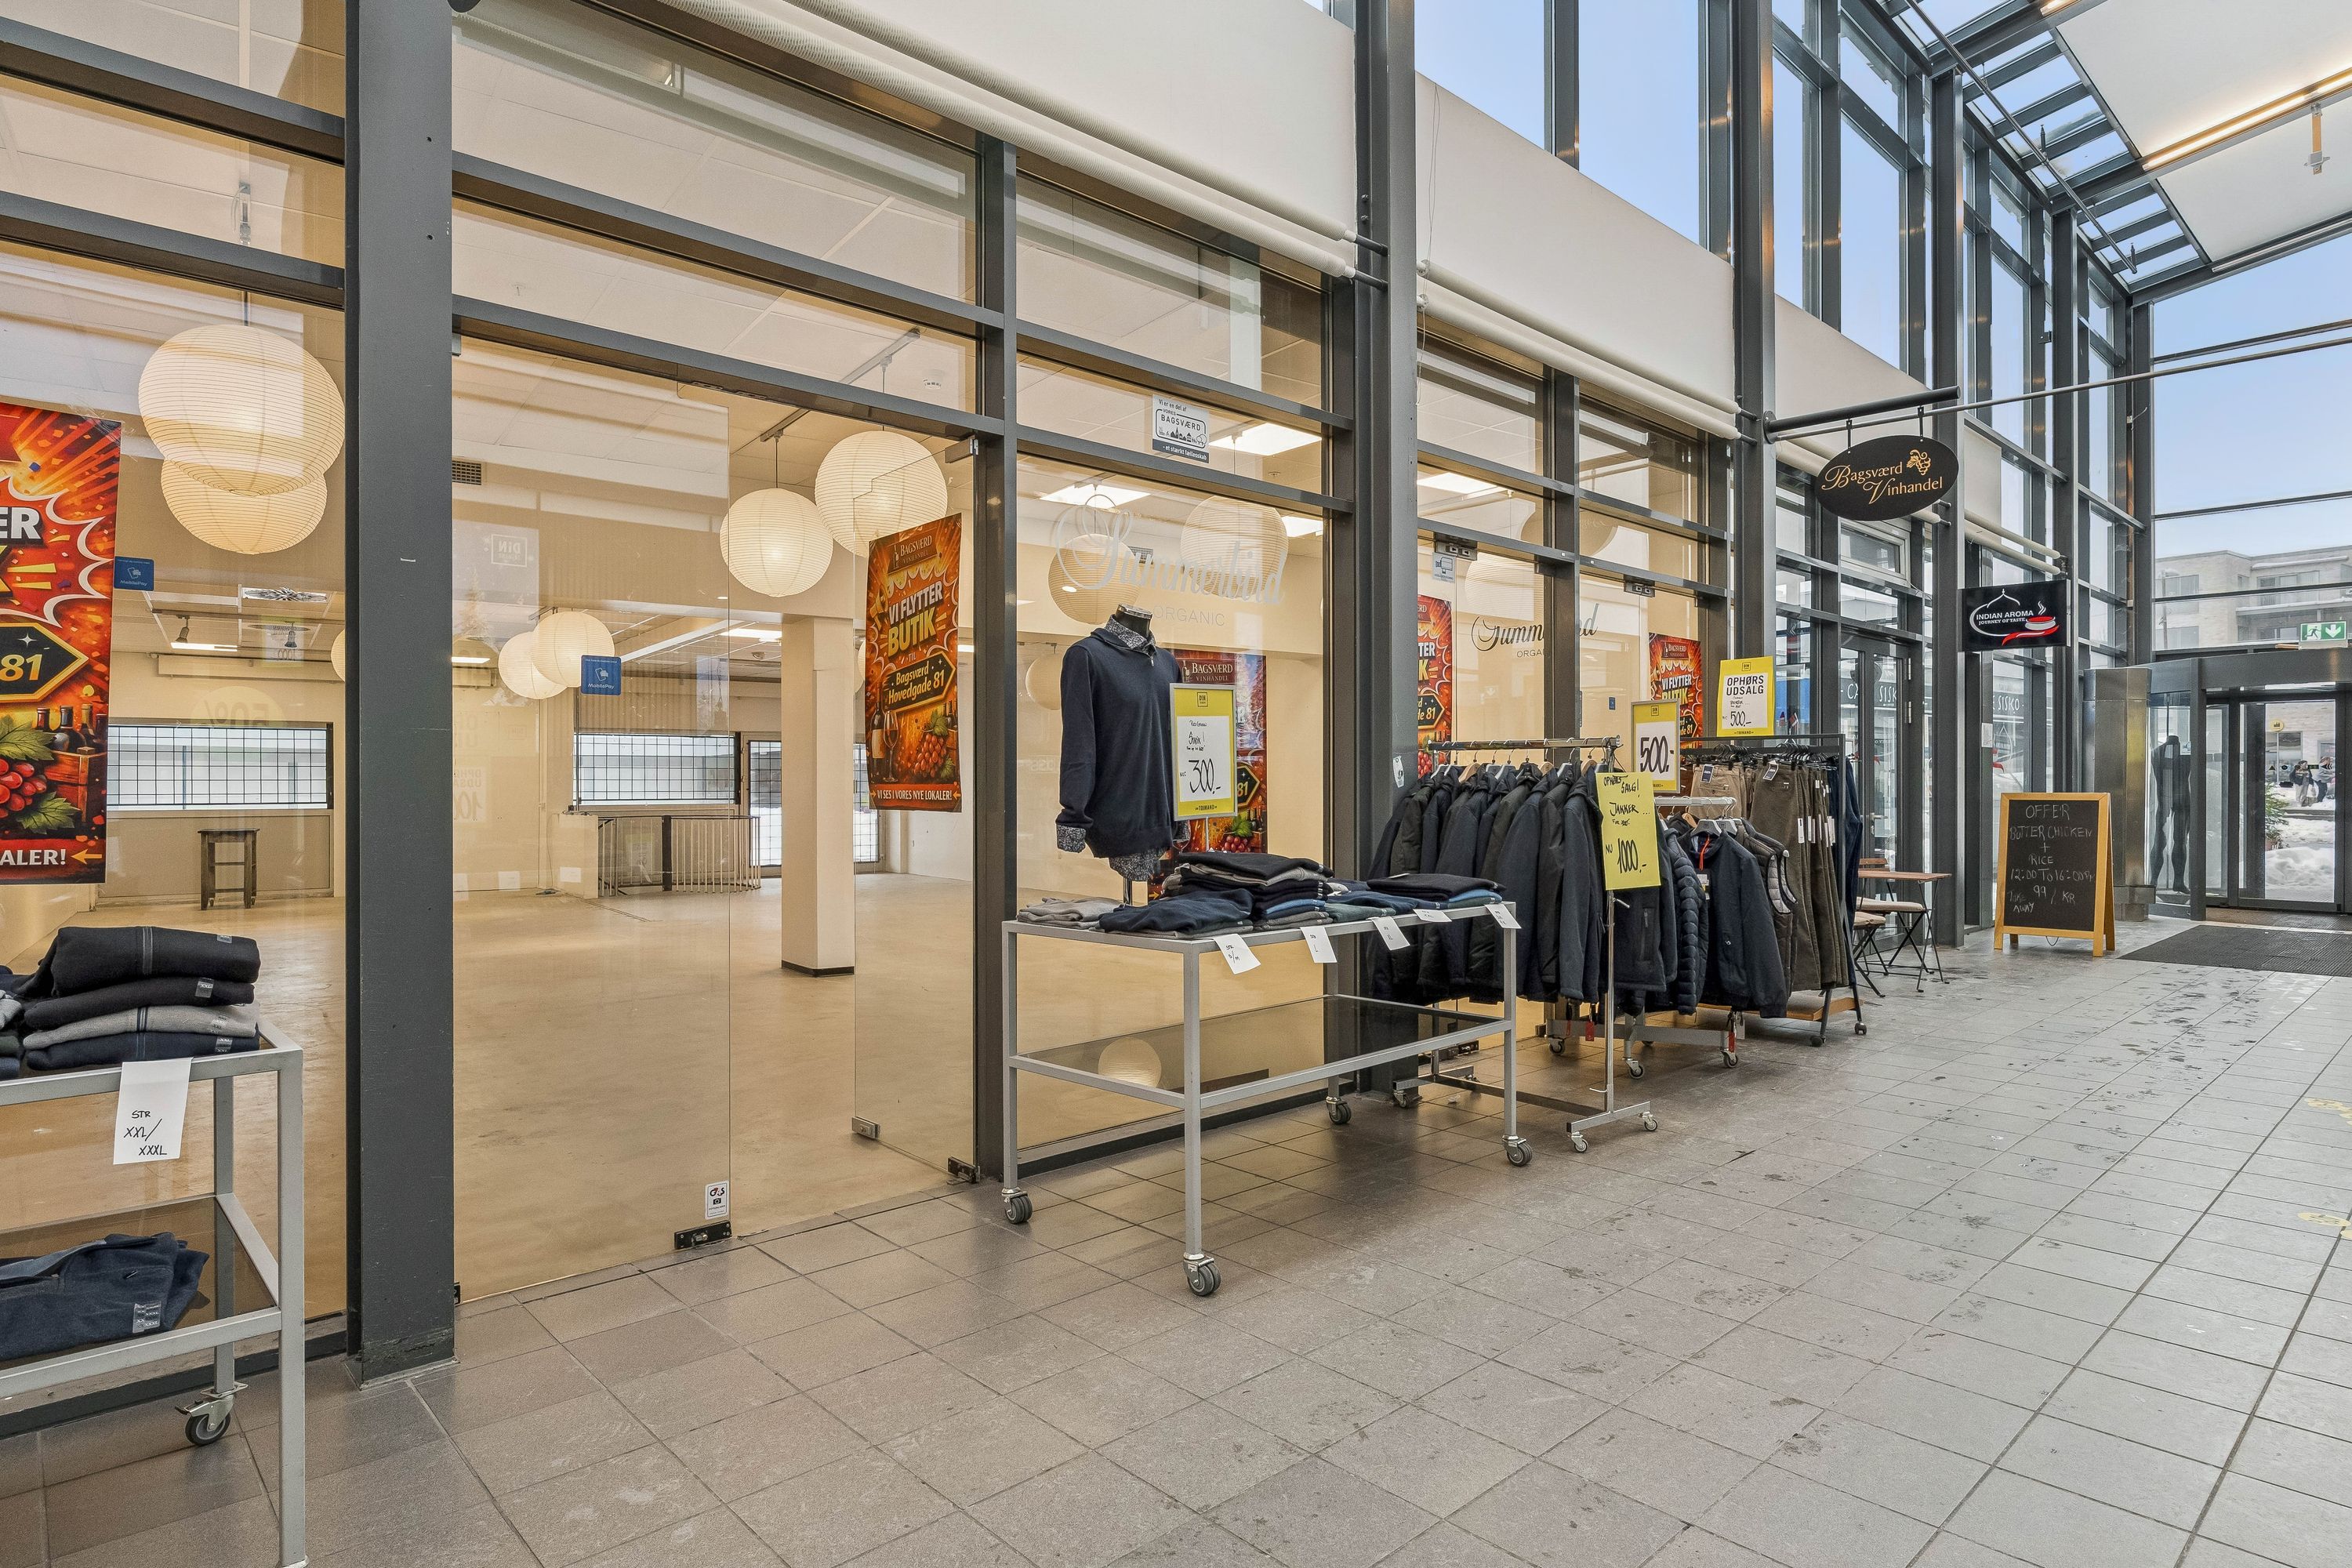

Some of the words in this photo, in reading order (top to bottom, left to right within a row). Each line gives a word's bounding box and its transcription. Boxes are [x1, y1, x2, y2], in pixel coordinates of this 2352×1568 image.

[1161, 414, 1201, 431] BAGSVÆRD
[1821, 461, 1903, 490] Bagsværd
[1863, 476, 1943, 505] Vinhandel
[900, 535, 932, 557] BAGSVÆRD
[888, 603, 899, 625] VI
[900, 581, 943, 619] FLYTTER
[1154, 604, 1225, 626] ORGANIC
[887, 606, 936, 658] BUTIK
[0, 653, 43, 682] 81
[896, 660, 929, 686] Bagsværd
[1192, 662, 1233, 674] BAGSVÆRD
[888, 677, 931, 705] Hovedgade
[933, 670, 945, 689] 81
[1662, 677, 1668, 691] VI
[1669, 673, 1693, 689] FLYTTER
[1727, 675, 1764, 687] OPHØRS
[1726, 684, 1764, 696] UDSALG
[1998, 694, 2020, 712] SISKO
[1425, 706, 1436, 720] 81
[877, 789, 883, 799] VI
[883, 789, 891, 800] SES
[895, 789, 912, 800] VORES
[913, 789, 924, 800] NYE
[924, 790, 953, 800] LOKALER!
[1237, 781, 1249, 797] 81
[2025, 803, 2070, 820] OFFER
[2009, 825, 2045, 840] BUTTER
[2047, 826, 2092, 840] CHICKEN
[1605, 844, 1613, 854] NU
[2029, 854, 2054, 866] RICE
[2062, 891, 2076, 905] KR
[2013, 902, 2034, 913] AWAY
[132, 1110, 151, 1119] STR
[139, 1145, 168, 1156] XXXL
